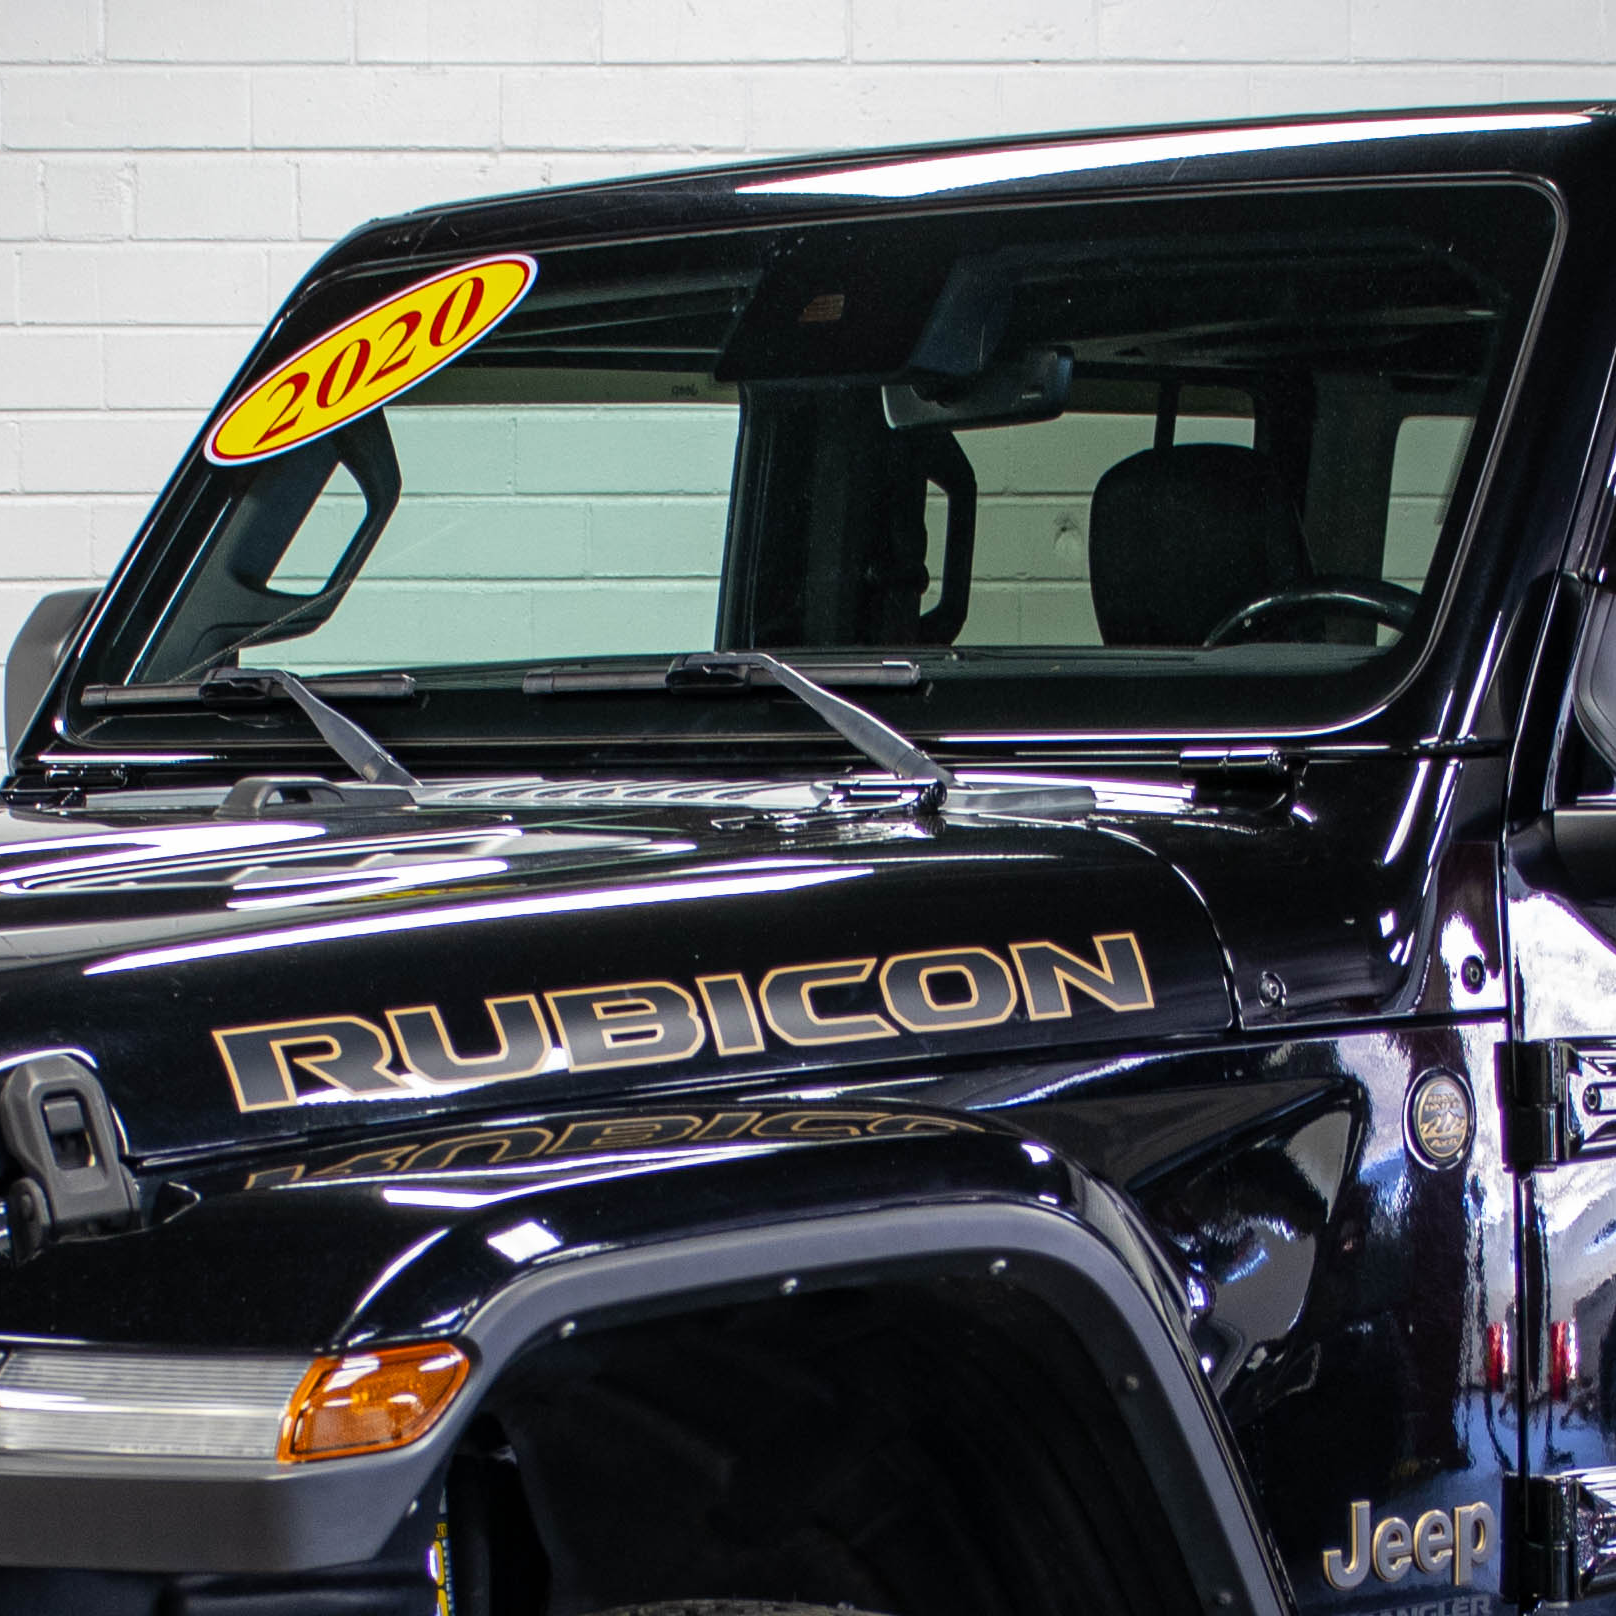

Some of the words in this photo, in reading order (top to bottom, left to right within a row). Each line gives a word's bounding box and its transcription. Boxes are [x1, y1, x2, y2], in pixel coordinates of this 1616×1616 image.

[253, 276, 484, 448] 2020
[211, 932, 1155, 1113] RUBICON
[1322, 1499, 1496, 1592] Jeep
